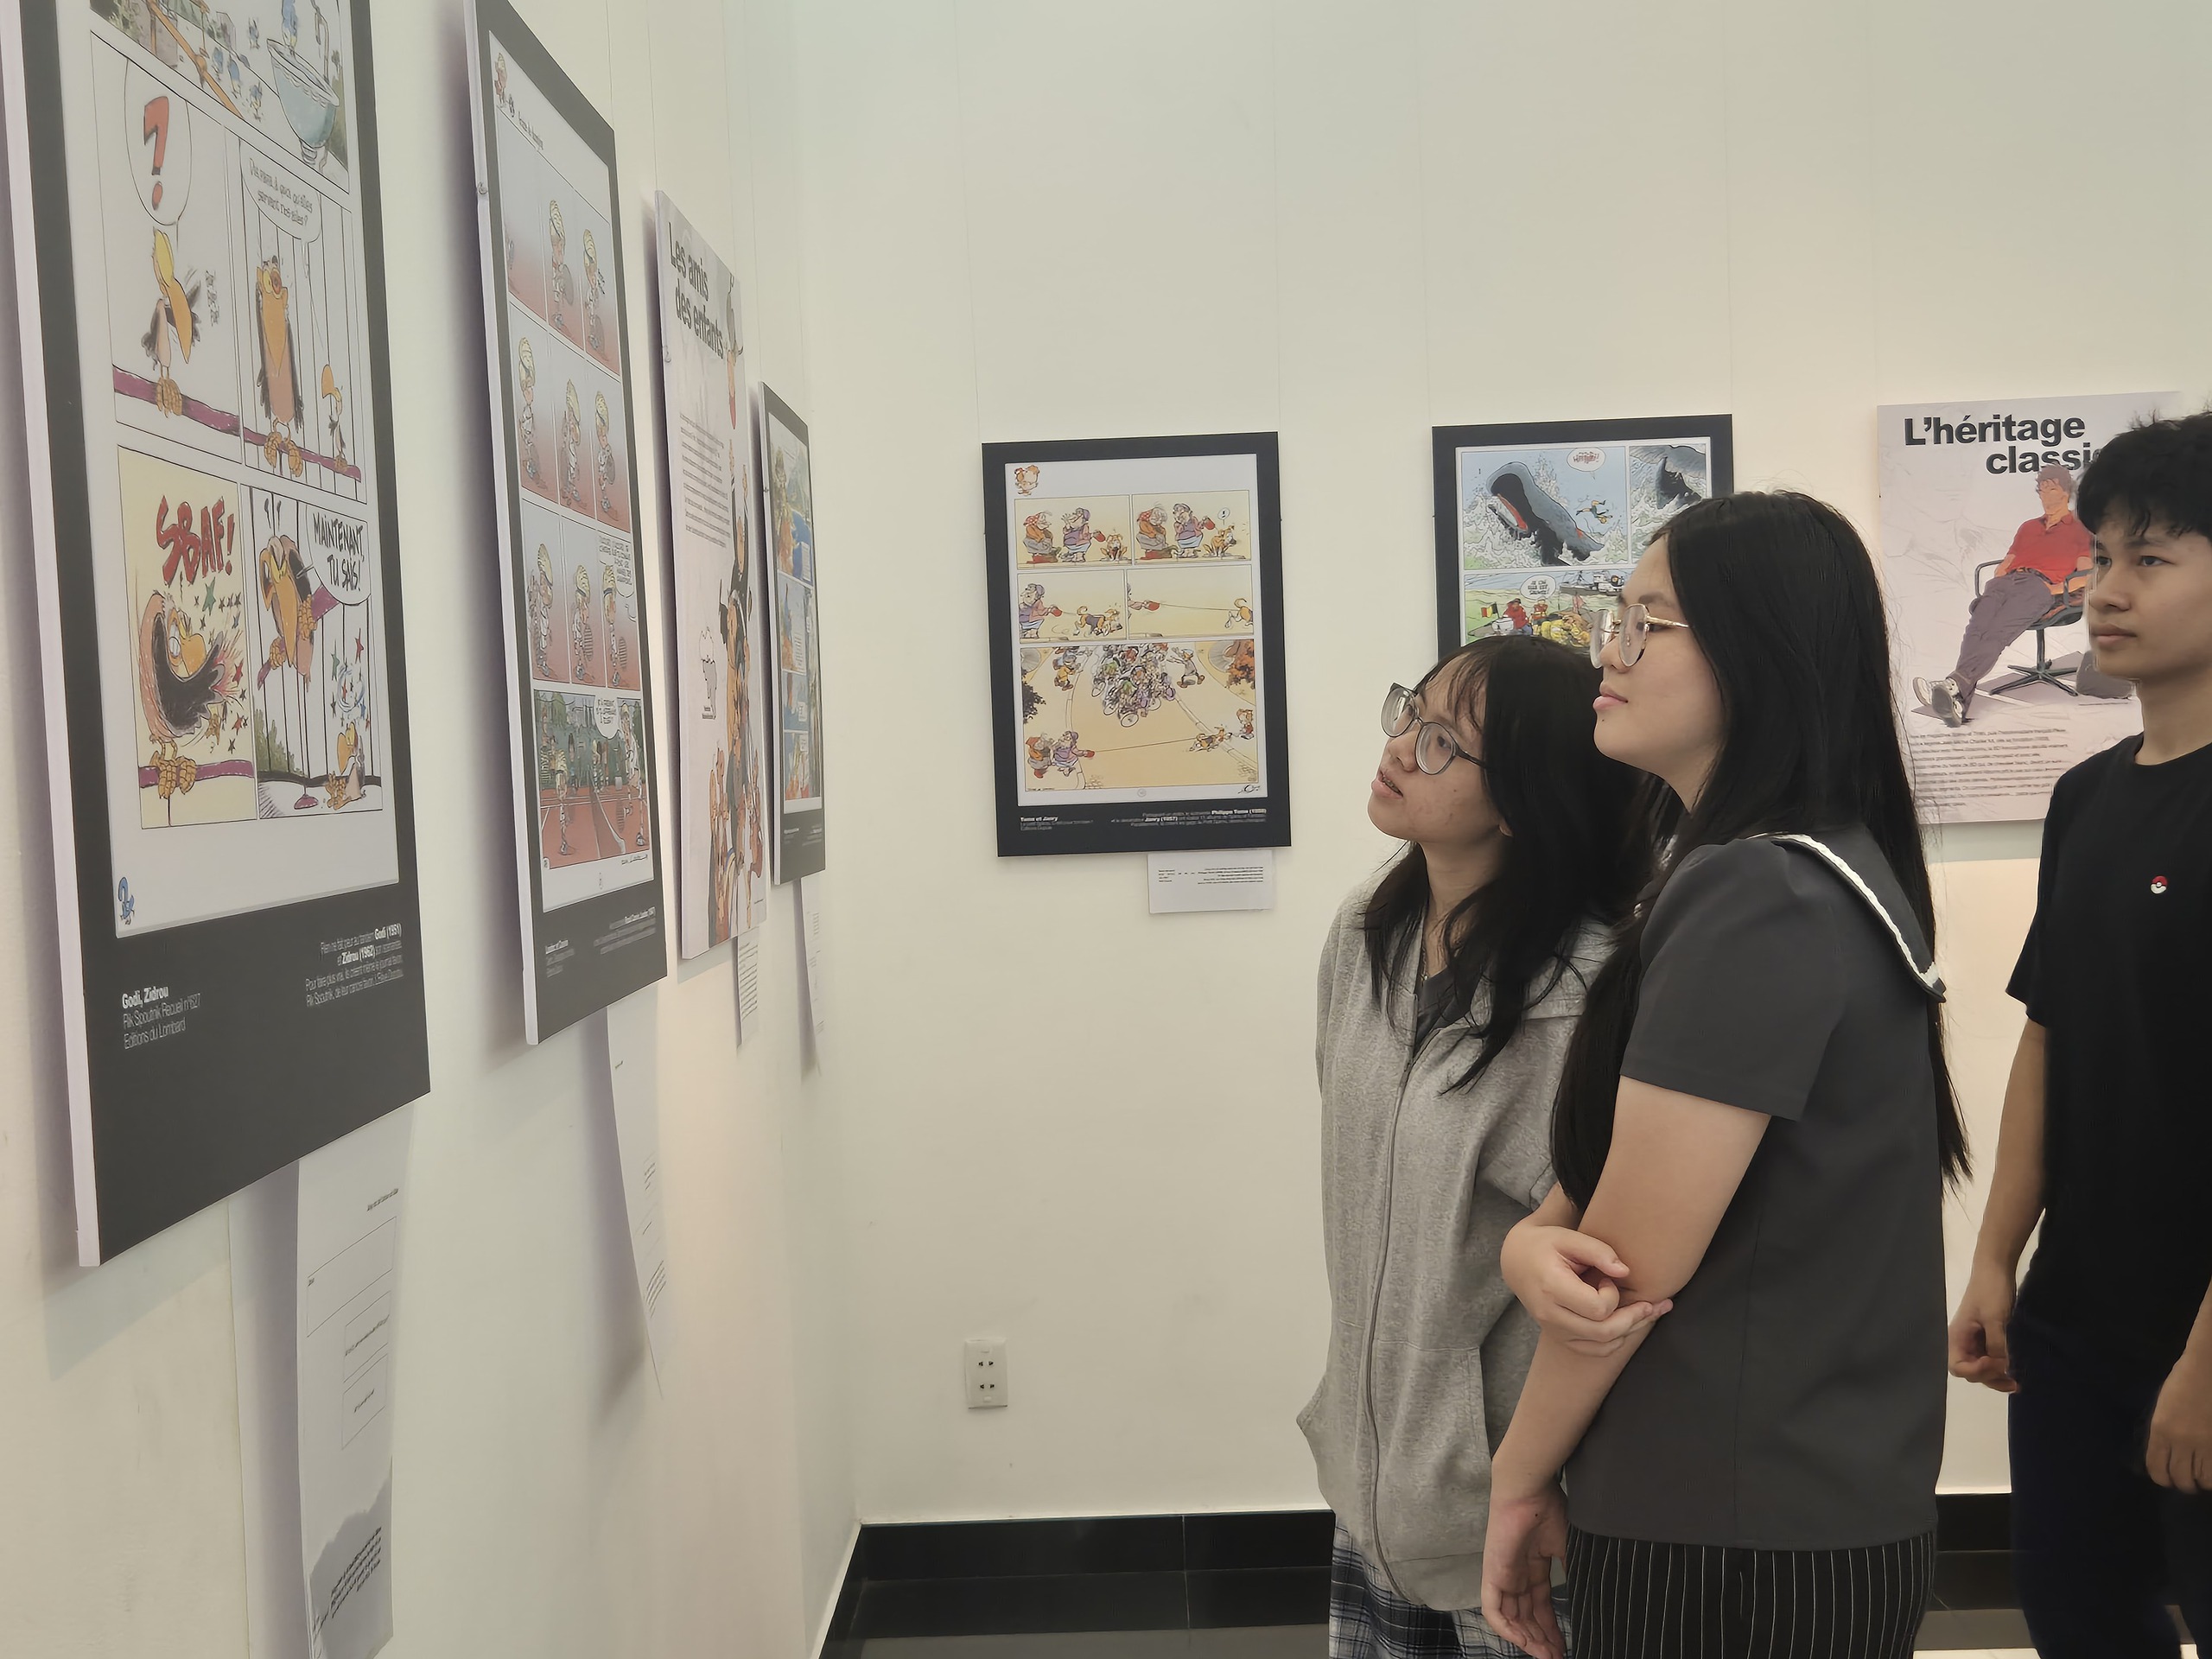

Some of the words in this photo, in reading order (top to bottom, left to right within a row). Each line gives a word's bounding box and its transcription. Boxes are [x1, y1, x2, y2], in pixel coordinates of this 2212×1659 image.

[668, 221, 687, 279] Les
[688, 257, 709, 302] amis
[675, 277, 692, 330] des
[693, 304, 724, 359] enfants
[1986, 442, 2101, 474] classi
[156, 494, 235, 588] SBAF!
[327, 554, 340, 587] TU
[341, 557, 361, 592] SAIS!
[122, 989, 143, 1009] Godi,
[143, 986, 169, 1003] Zidrou
